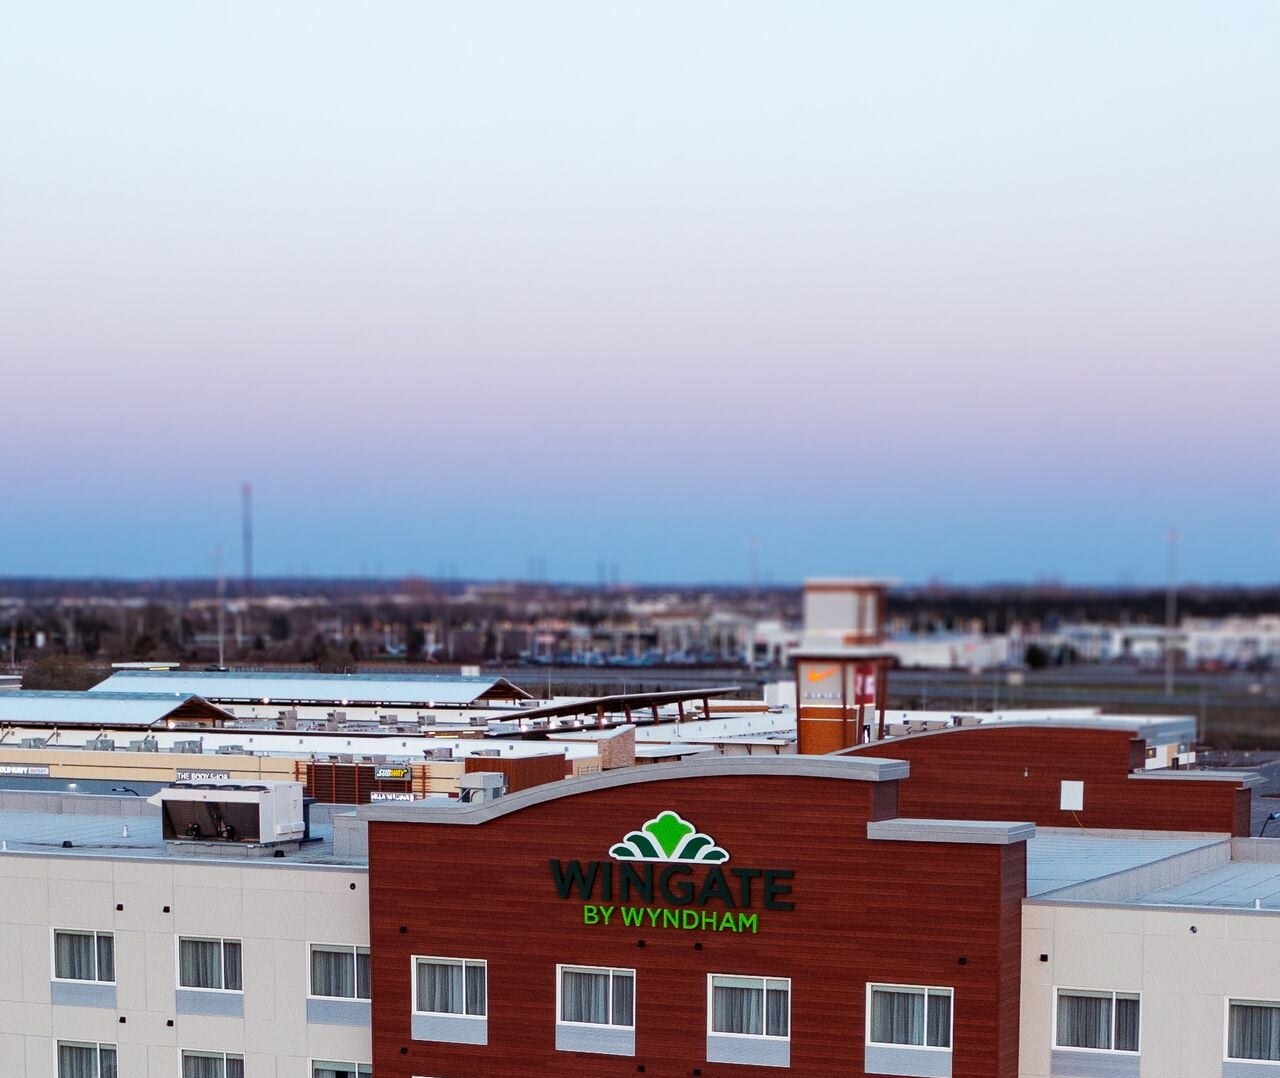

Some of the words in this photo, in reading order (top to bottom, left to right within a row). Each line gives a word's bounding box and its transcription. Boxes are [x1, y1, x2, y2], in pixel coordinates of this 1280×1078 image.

[177, 772, 190, 780] THE
[376, 768, 408, 777] SUBWAY
[549, 859, 795, 911] WINGATE
[583, 905, 615, 926] BY
[621, 906, 759, 934] WYNDHAM
